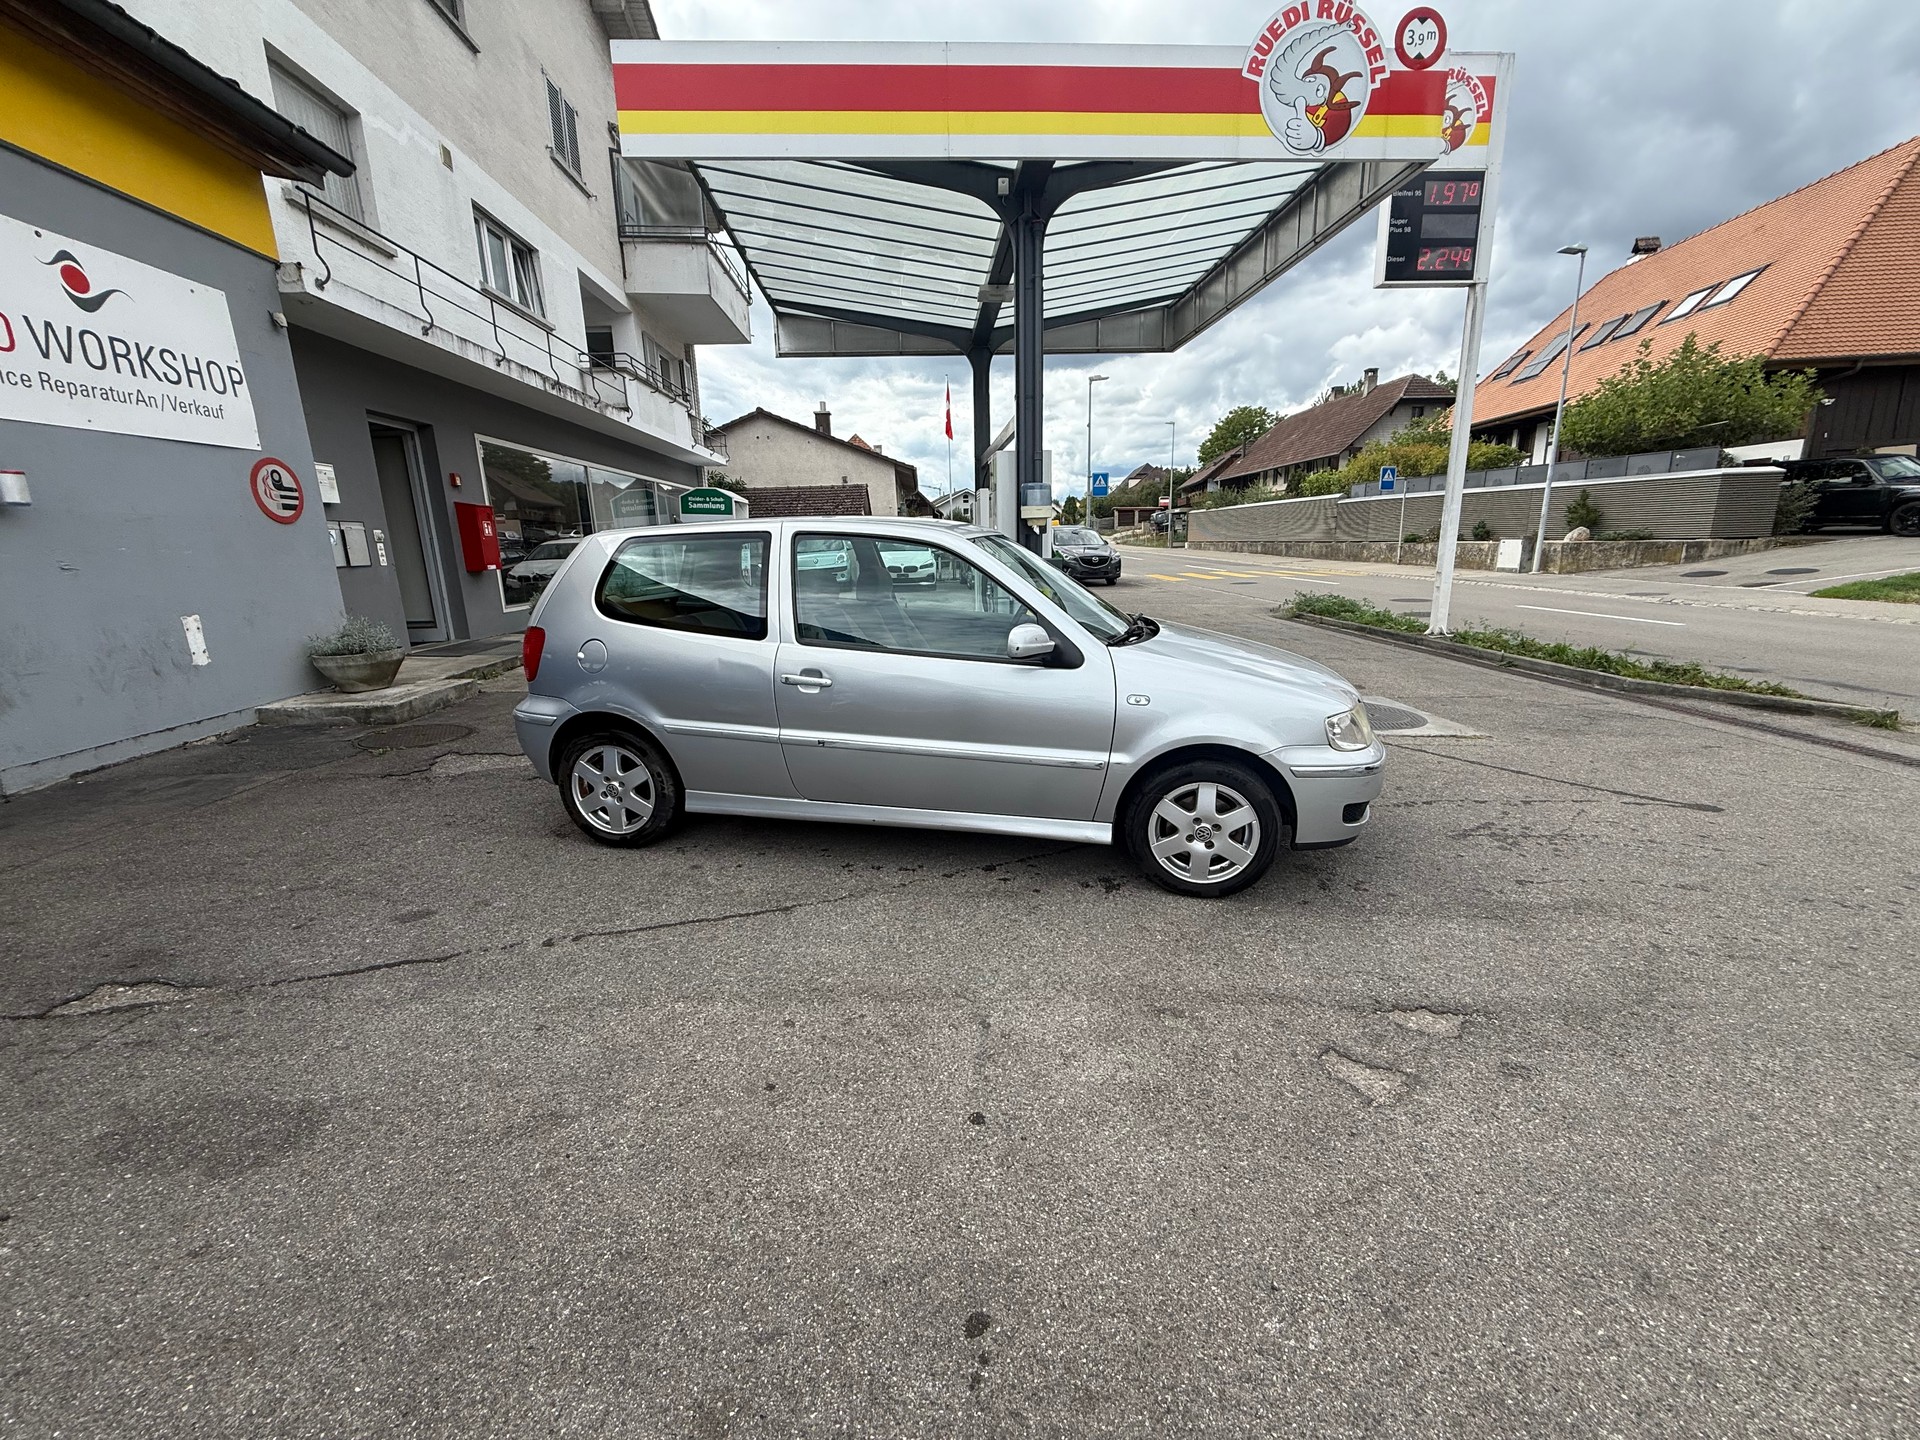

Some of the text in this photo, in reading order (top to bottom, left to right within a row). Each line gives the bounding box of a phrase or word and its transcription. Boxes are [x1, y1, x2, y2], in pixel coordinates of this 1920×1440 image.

[1247, 0, 1386, 84] RUEDI RÜSSEL
[1414, 189, 1422, 197] 95
[22, 314, 244, 398] WORKSHOP
[688, 502, 725, 511] Sammlung
